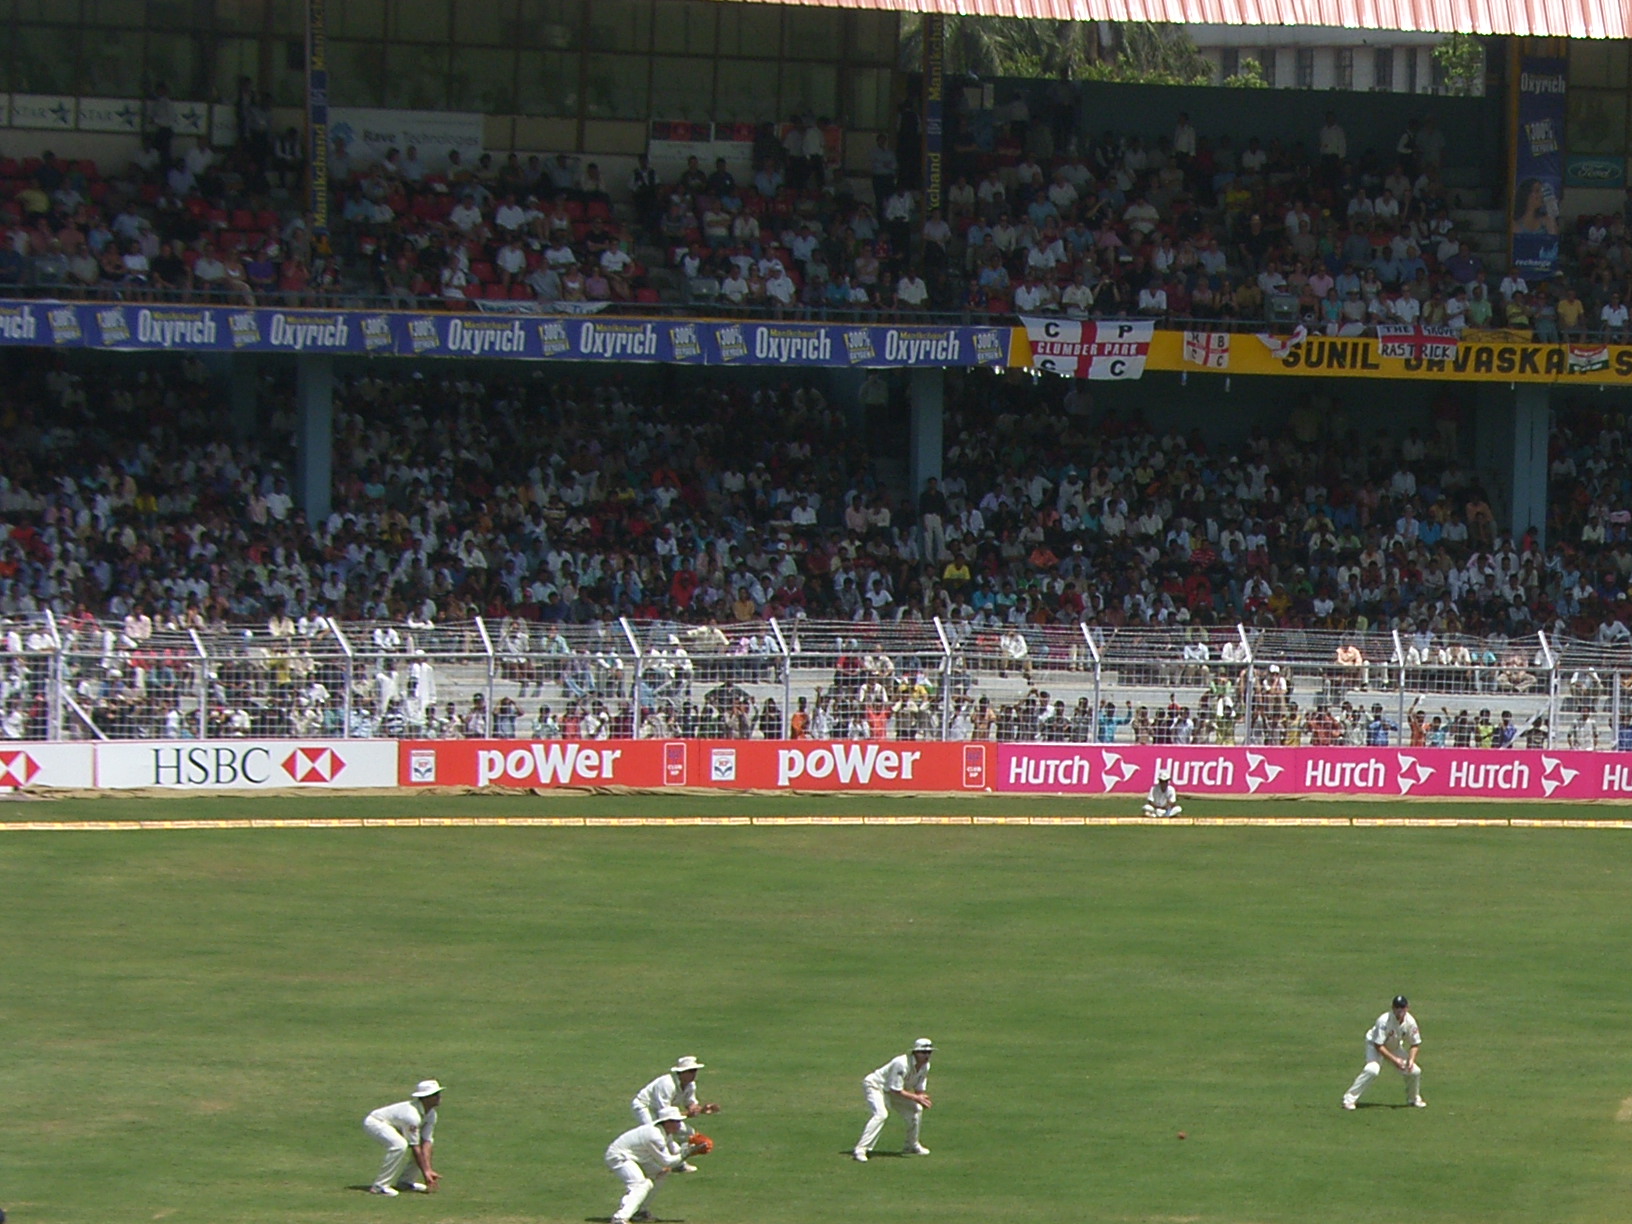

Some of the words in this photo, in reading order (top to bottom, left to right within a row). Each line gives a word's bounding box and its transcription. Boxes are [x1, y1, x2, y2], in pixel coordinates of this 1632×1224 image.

[1520, 72, 1566, 94] Oxyrich
[138, 309, 217, 347] Oxyrich
[271, 312, 349, 350] Oxyrich
[448, 318, 525, 355] Oxyrich
[580, 321, 657, 358] Oxyrich
[755, 326, 831, 362] Oxyrich
[1044, 322, 1060, 337] C
[1118, 324, 1132, 337] P
[885, 329, 959, 363] Oxyrich
[1037, 342, 1098, 356] CLUMBER
[1104, 342, 1138, 355] PARK
[1282, 341, 1380, 371] SUNIL
[1404, 345, 1587, 374] VASKA
[1109, 360, 1126, 376] C
[151, 747, 270, 785] HSBC
